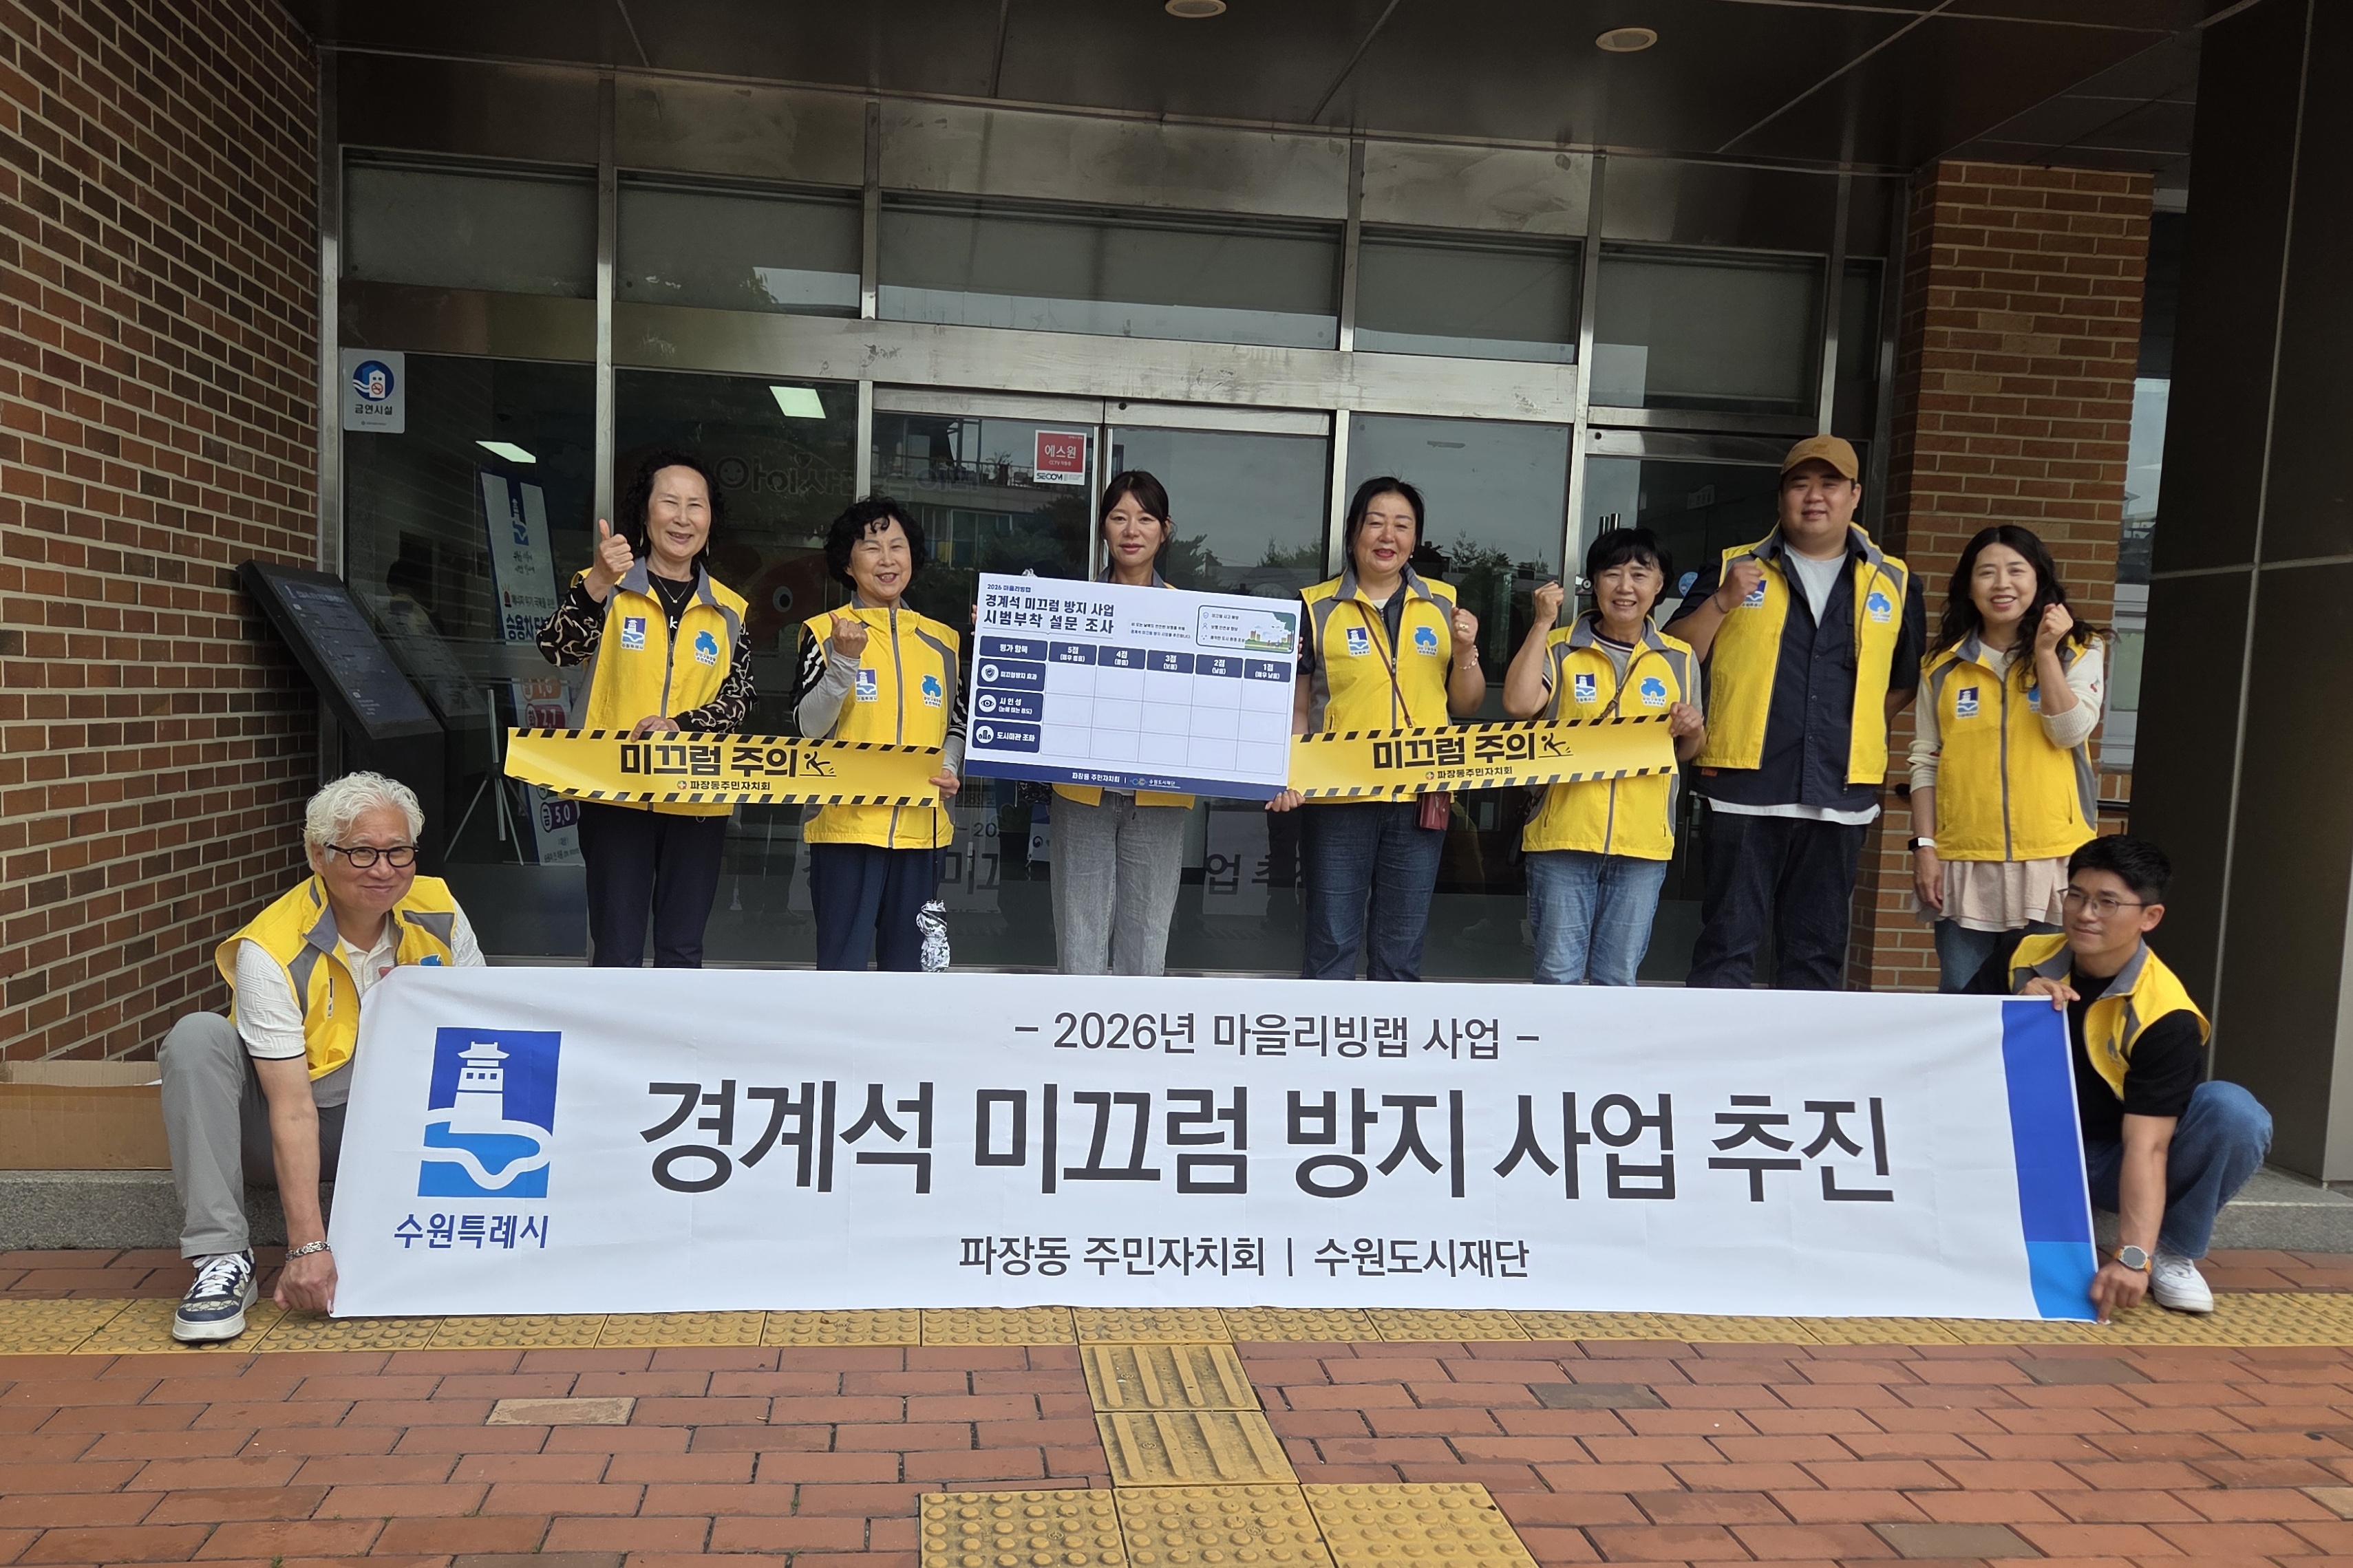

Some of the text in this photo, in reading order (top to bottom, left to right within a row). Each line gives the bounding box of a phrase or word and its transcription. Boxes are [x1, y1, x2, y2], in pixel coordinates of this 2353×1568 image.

[354, 404, 393, 416] 금연시설
[1044, 444, 1077, 459] 에스원
[985, 594, 1115, 618] 경계석 미끄럼 방지 사업
[506, 613, 534, 641] 승용차
[983, 609, 1114, 634] 시범부착 설문 조사
[620, 744, 798, 777] 미끄럼 주의
[1372, 733, 1536, 770] 미끄럼 주의
[690, 780, 771, 791] 파장동주민자치회
[1436, 766, 1513, 780] 파장동주민자치회
[1054, 1012, 1499, 1060] 2026년 마을리빙랩 사업
[639, 1079, 1895, 1203] 경계석 미끄럼 방지 사업 추진
[394, 1213, 549, 1249] 수원특례시
[959, 1236, 1530, 1278] 파장동 주민자치회 수원도시재단
